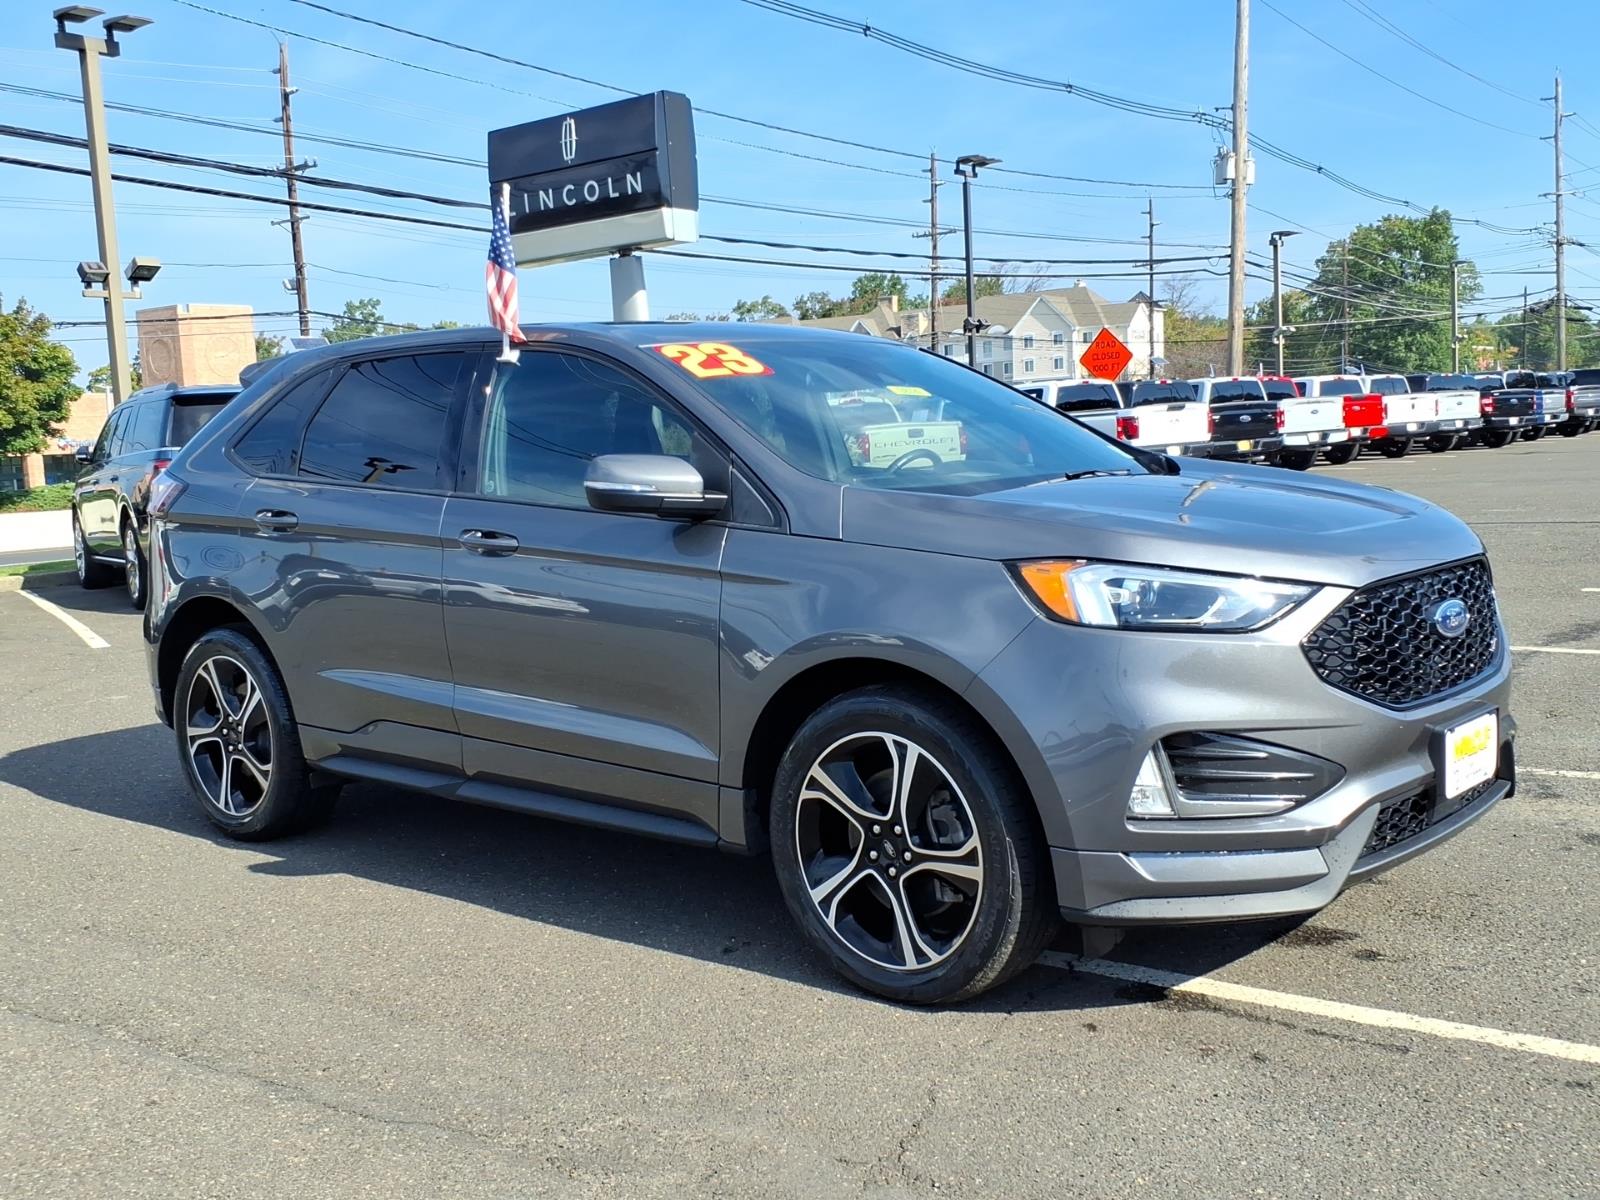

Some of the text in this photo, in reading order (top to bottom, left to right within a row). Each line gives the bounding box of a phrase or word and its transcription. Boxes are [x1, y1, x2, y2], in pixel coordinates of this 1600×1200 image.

[1095, 340, 1116, 349] ROAD
[660, 342, 765, 378] 23
[1092, 352, 1120, 361] CLOSED
[1092, 363, 1120, 372] 1000 FT
[873, 436, 955, 449] CHEVROLET
